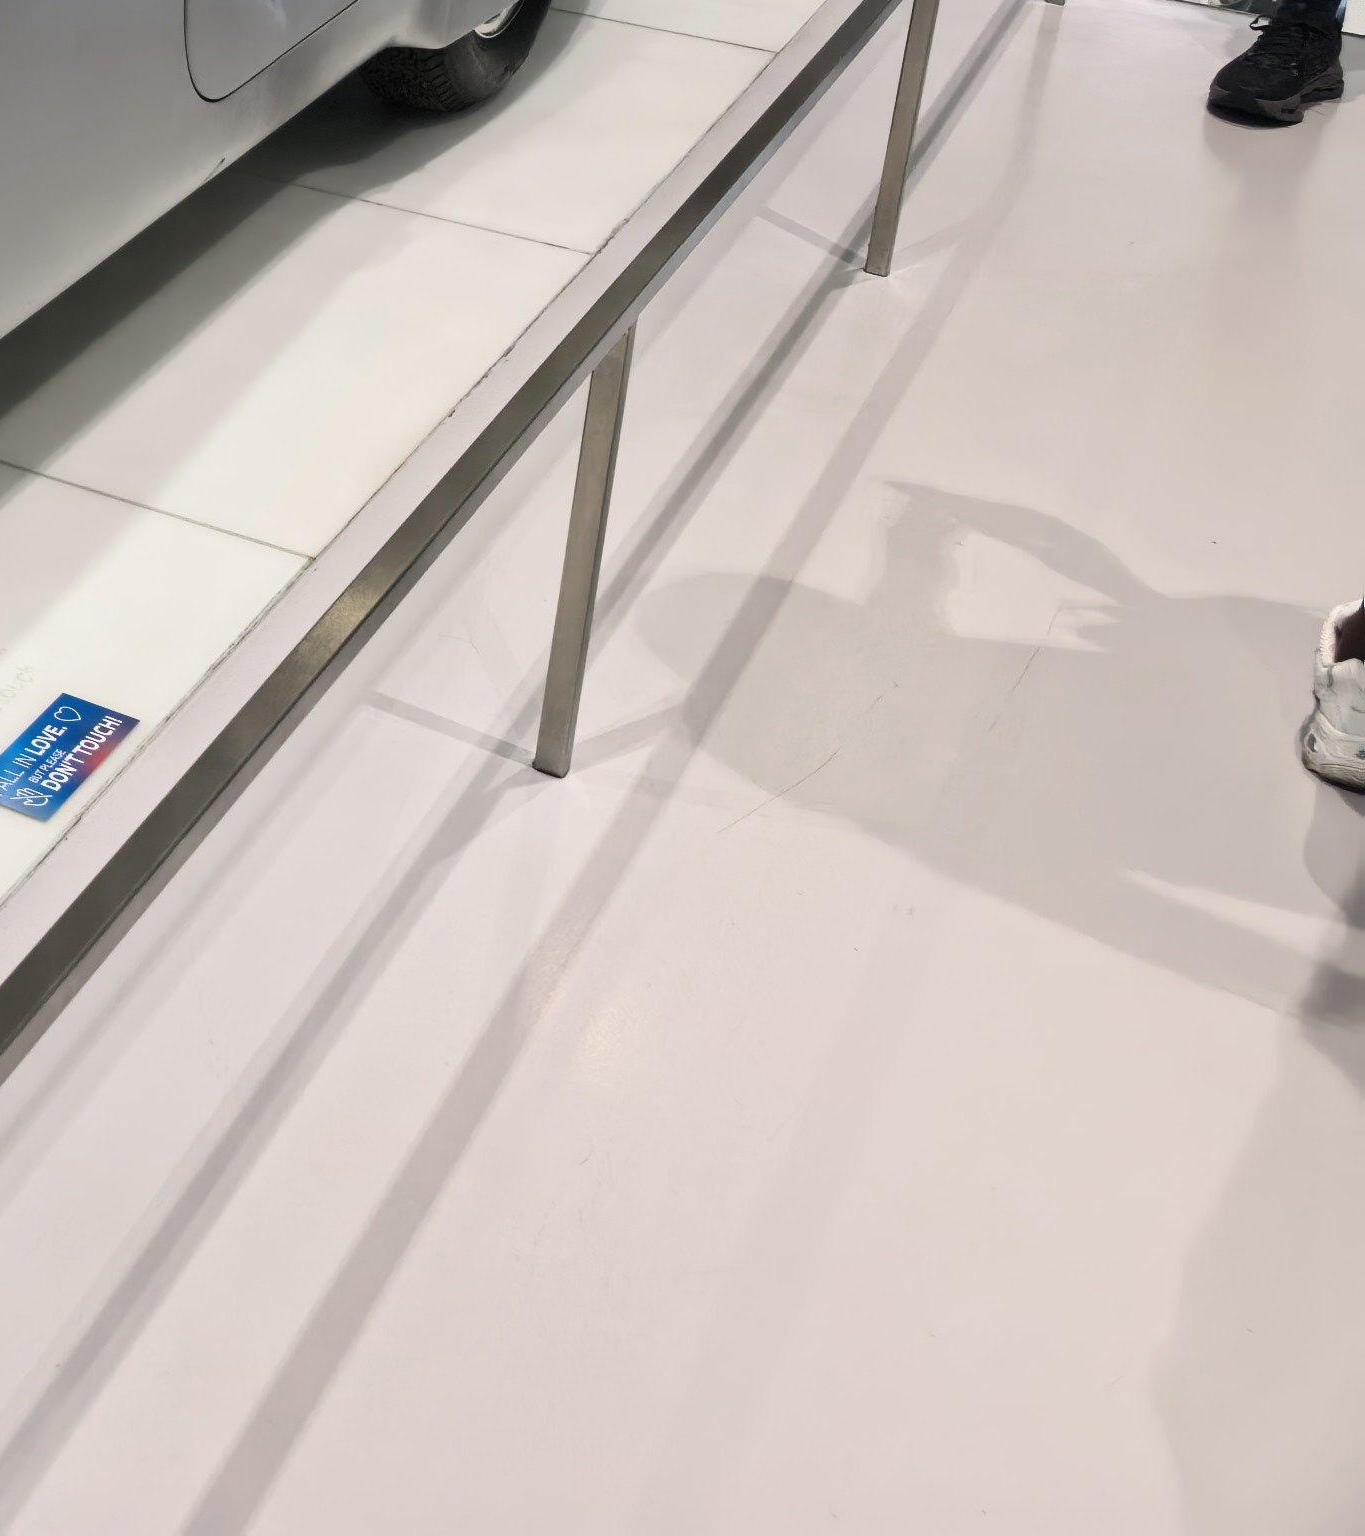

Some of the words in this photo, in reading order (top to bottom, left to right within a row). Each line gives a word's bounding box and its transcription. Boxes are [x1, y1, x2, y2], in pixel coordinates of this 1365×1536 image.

[24, 724, 68, 756] LOVE.
[40, 753, 85, 792] DON'T
[71, 715, 123, 756] TOUCH!
[12, 753, 37, 769] IN
[28, 767, 47, 784] BUT
[41, 748, 68, 772] PLEASE
